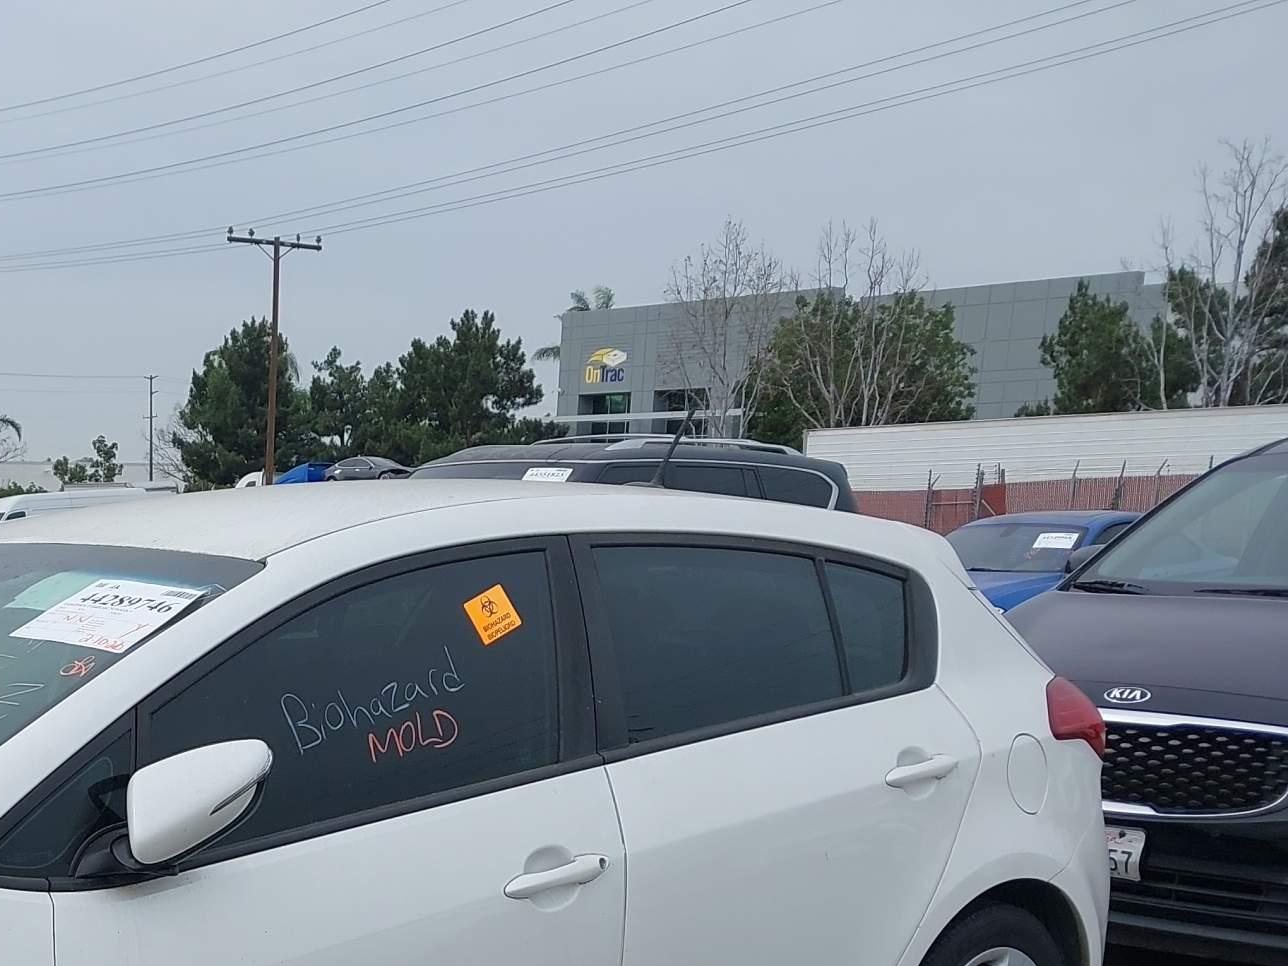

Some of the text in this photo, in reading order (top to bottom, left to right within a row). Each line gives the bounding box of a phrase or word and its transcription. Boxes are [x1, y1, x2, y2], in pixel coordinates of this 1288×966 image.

[585, 365, 625, 383] OnTrac
[79, 592, 178, 614] 44289746
[483, 613, 512, 633] BIOHAZARD
[279, 645, 465, 756] Biohazard
[1109, 688, 1143, 701] KIA
[367, 708, 459, 763] MOLD
